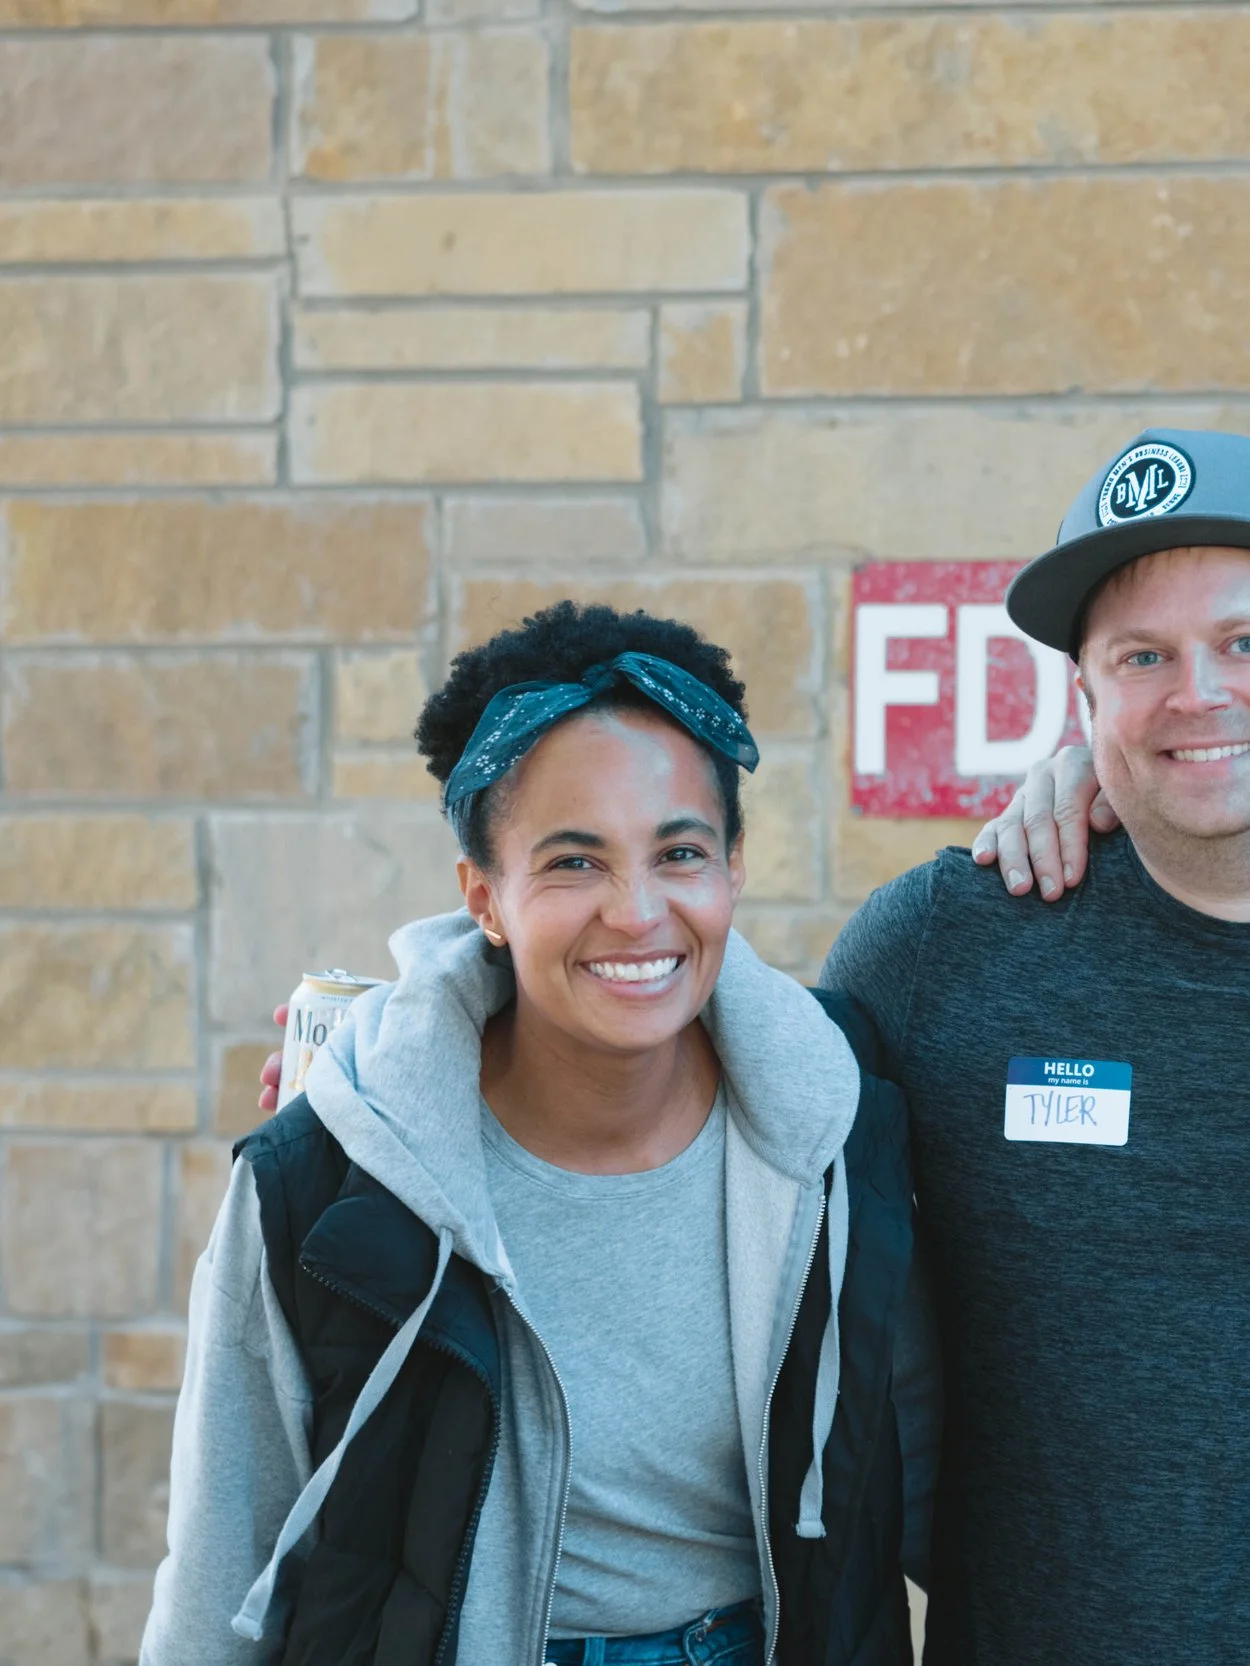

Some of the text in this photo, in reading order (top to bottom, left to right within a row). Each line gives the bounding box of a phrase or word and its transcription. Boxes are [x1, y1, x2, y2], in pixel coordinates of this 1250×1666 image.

[1135, 448, 1169, 459] BUSINESS
[854, 603, 1093, 777] FD
[1044, 1061, 1095, 1077] HELLO
[1048, 1077, 1089, 1086] my name is
[1023, 1090, 1098, 1127] TYLER
